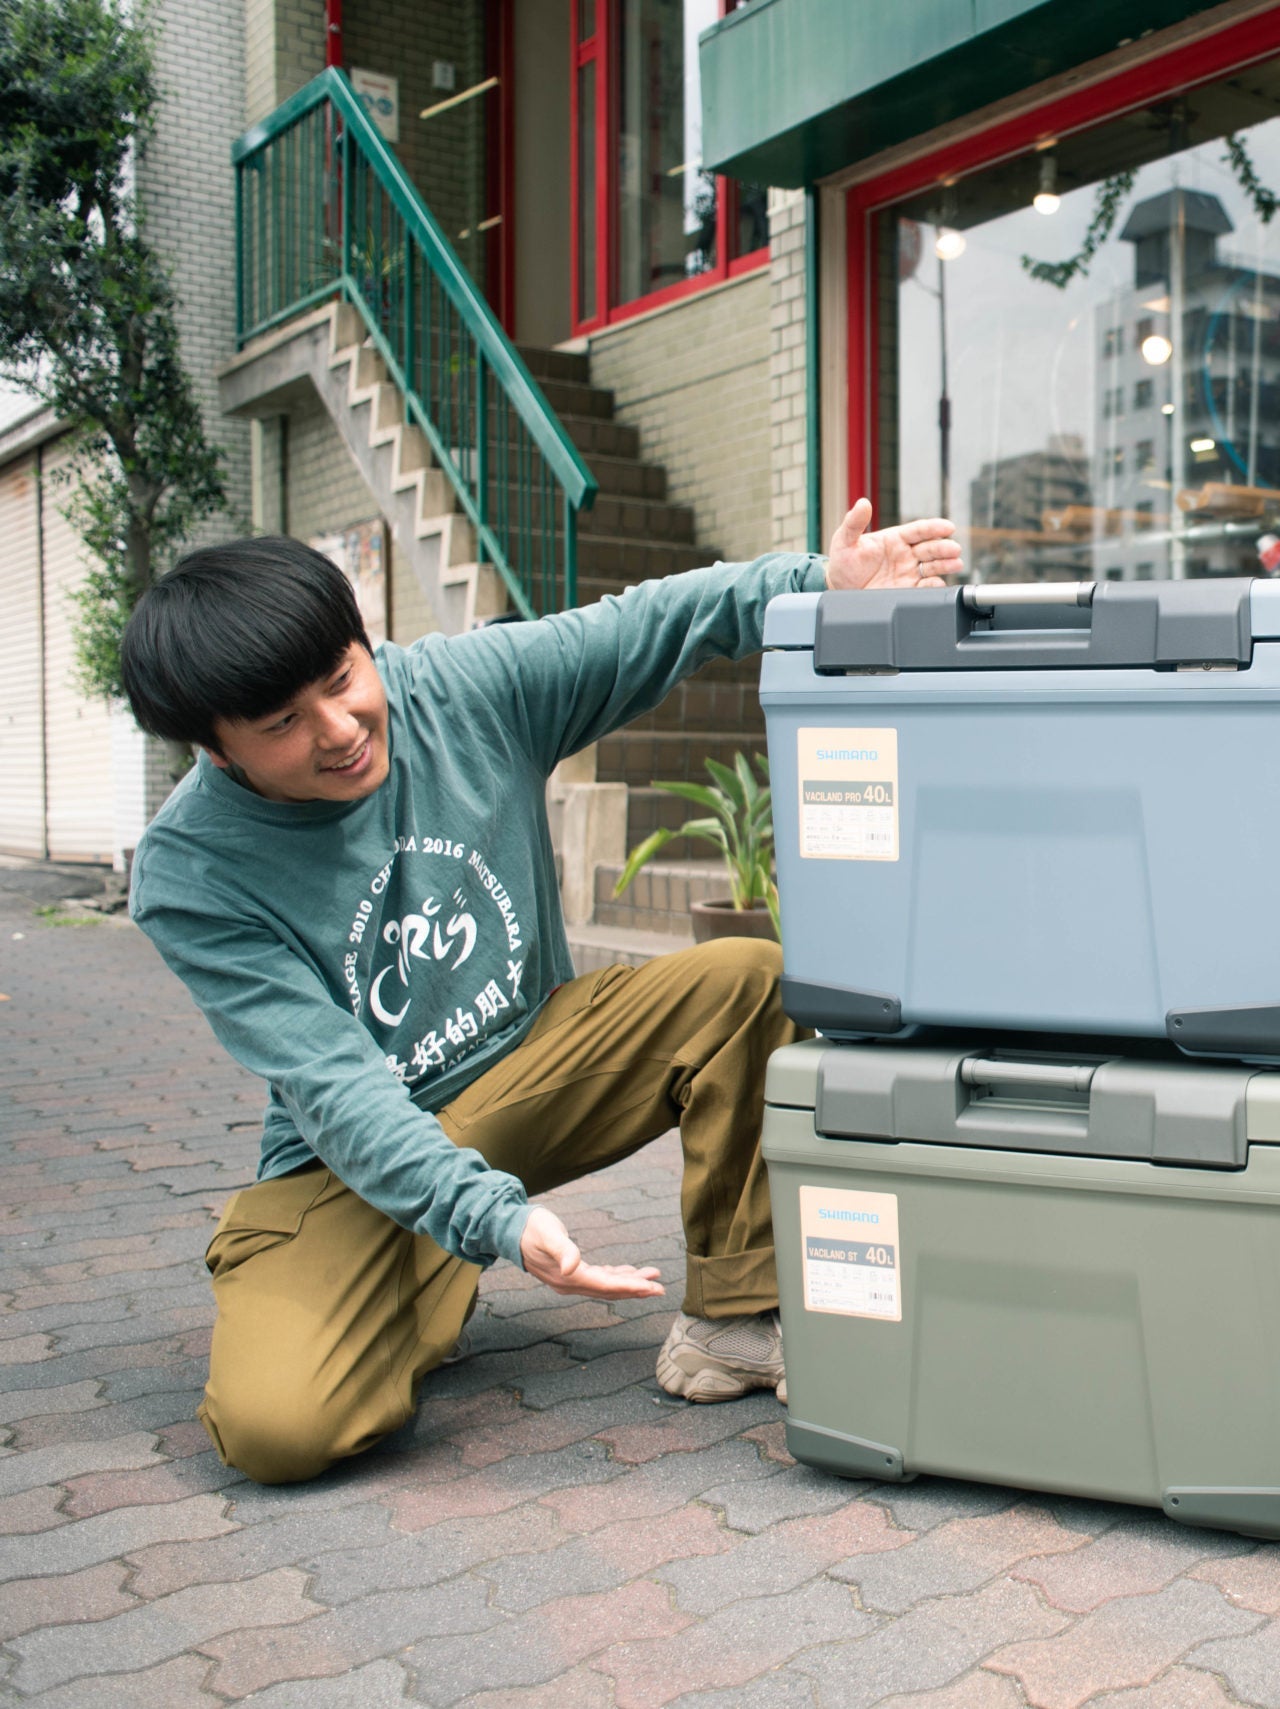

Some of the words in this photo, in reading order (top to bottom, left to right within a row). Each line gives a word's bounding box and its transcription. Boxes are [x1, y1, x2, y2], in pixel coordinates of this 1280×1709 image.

[816, 749, 879, 761] SHIMANO
[805, 791, 843, 802] VACILAND
[845, 792, 862, 803] PRO
[349, 899, 373, 944] 2010
[422, 837, 465, 859] 2016
[467, 850, 522, 952] MATSUBARA
[818, 1208, 879, 1224] SHIMANO
[808, 1247, 846, 1261] VACILAND
[847, 1251, 858, 1262] ST
